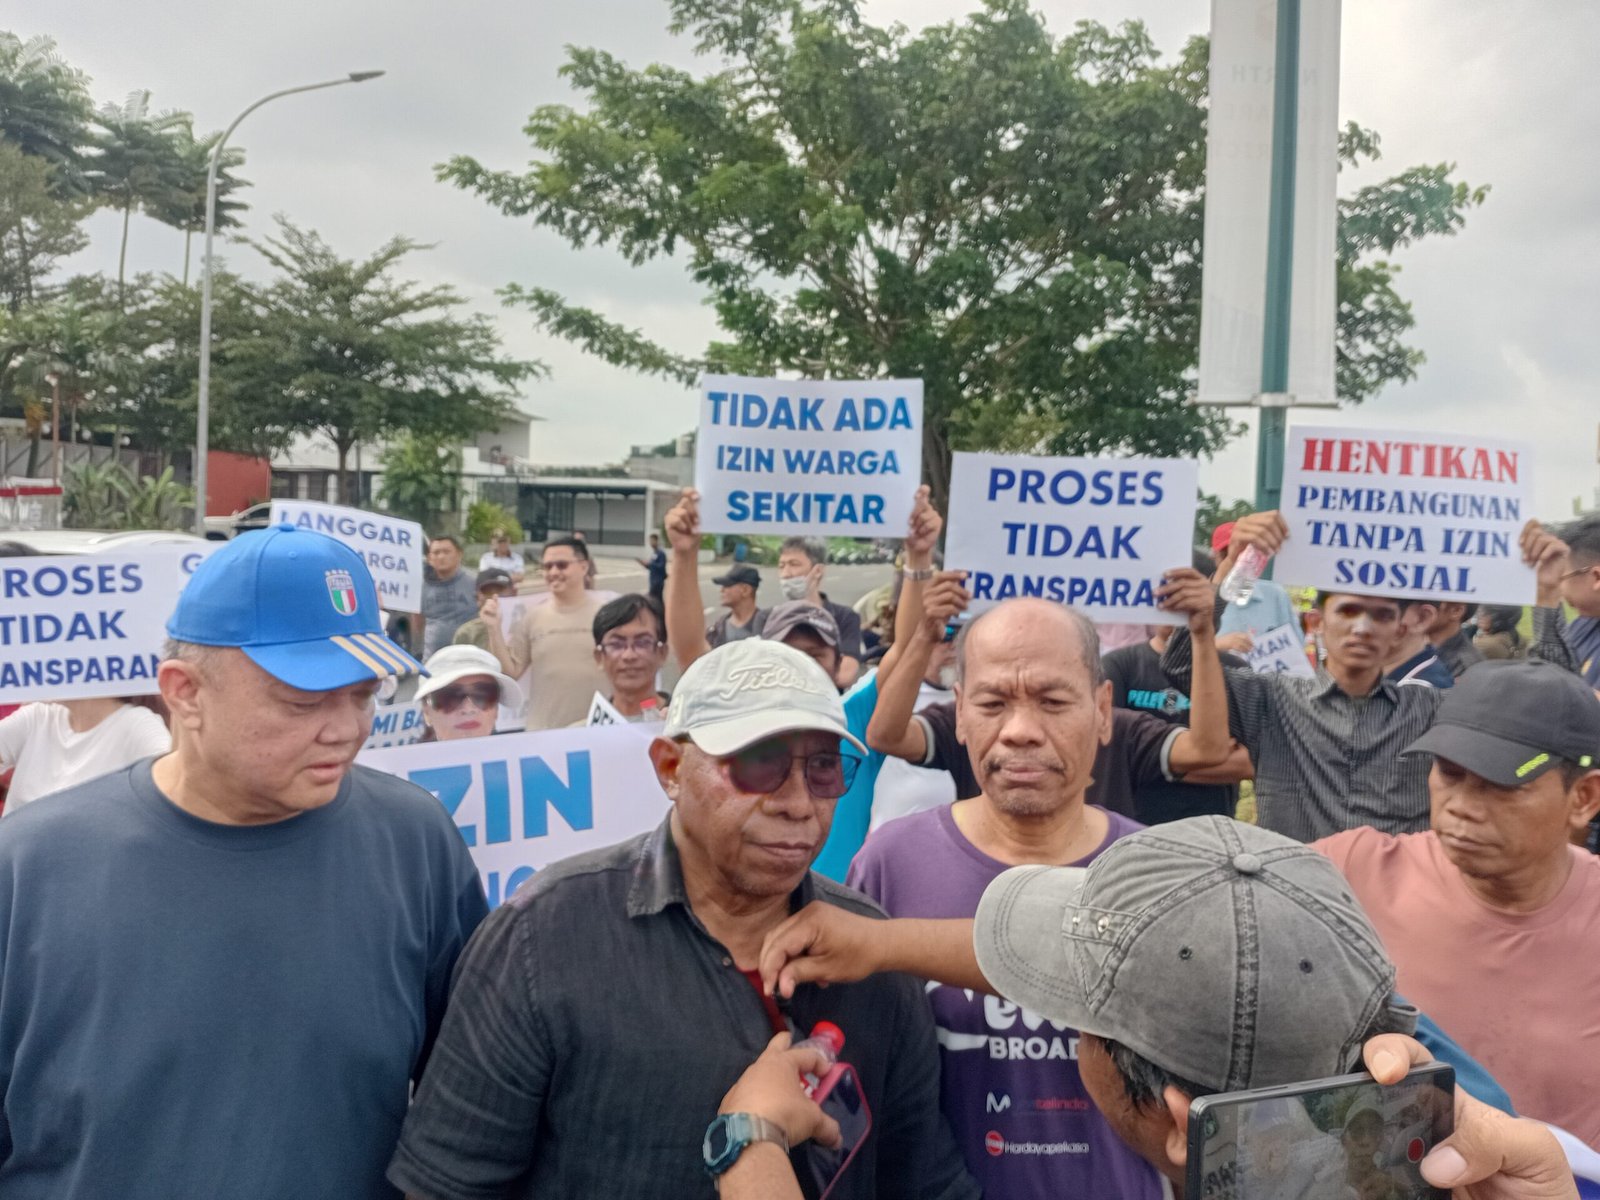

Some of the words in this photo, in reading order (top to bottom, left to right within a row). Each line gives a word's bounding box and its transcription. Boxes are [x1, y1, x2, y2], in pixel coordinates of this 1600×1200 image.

[708, 391, 824, 431] TIDAK
[833, 397, 913, 431] ADA
[716, 445, 774, 473] IZIN
[783, 448, 900, 475] WARGA
[1300, 437, 1519, 485] HENTIKAN
[987, 467, 1164, 506] PROSES
[1297, 484, 1521, 521] PEMBANGUNAN
[726, 490, 886, 524] SEKITAR
[1002, 522, 1143, 560] TIDAK
[1307, 519, 1426, 552] TANPA
[1441, 527, 1510, 558] IZIN
[0, 563, 143, 598] ROSES
[959, 571, 1172, 607] RANSPARA
[1334, 558, 1476, 593] SOSIAL
[0, 609, 127, 645] TIDAK
